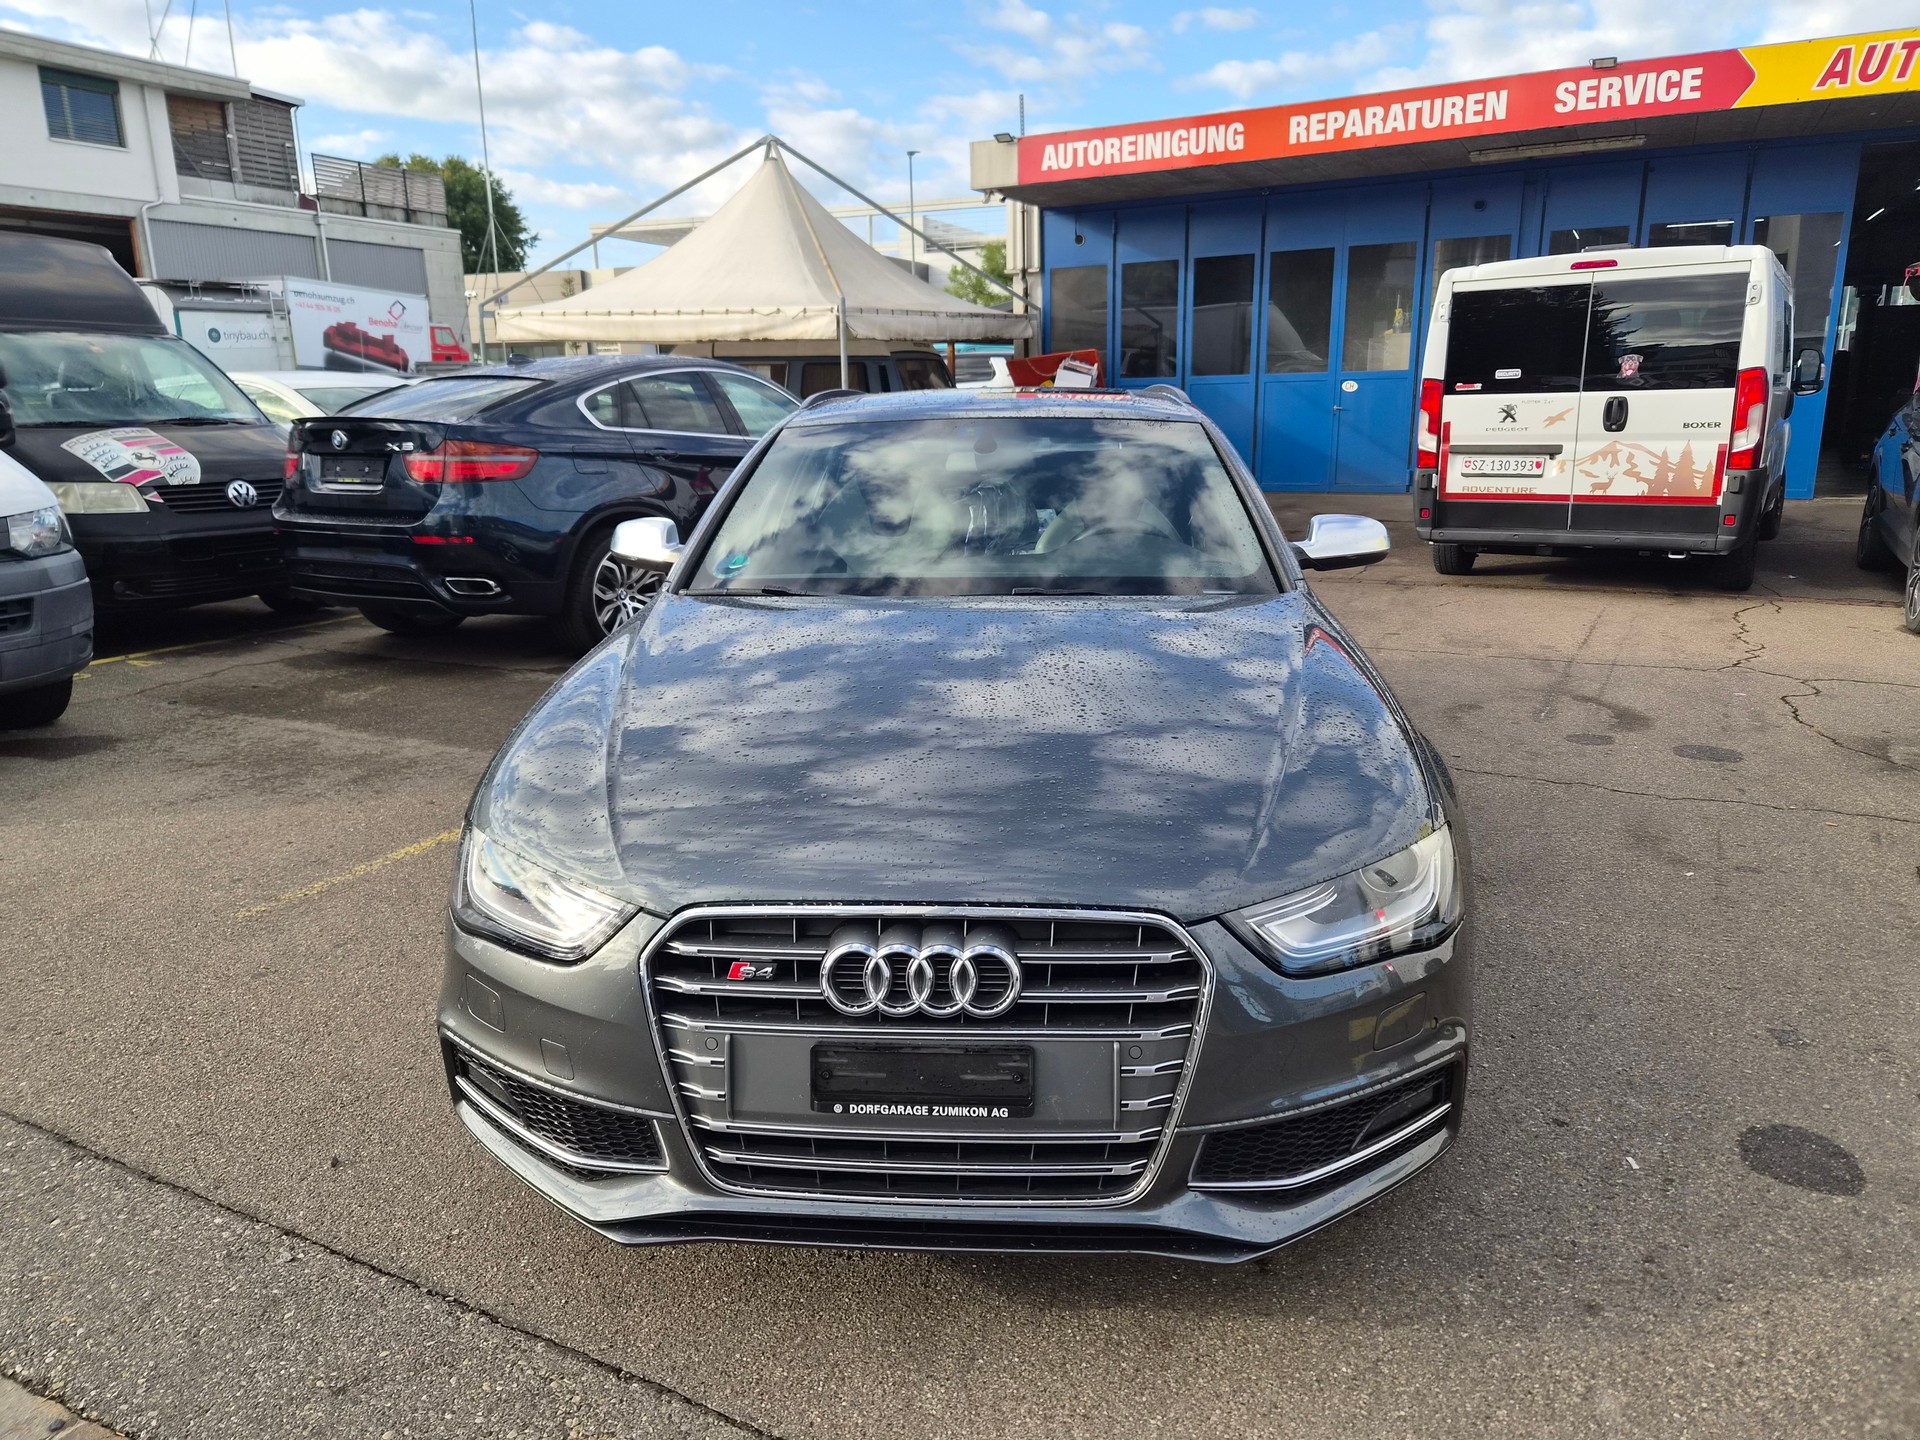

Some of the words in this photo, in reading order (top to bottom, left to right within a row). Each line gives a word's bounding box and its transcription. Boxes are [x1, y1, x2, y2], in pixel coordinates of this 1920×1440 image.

[1811, 38, 1920, 90] AUT
[1041, 122, 1245, 172] AUTOREINIGUNG
[1288, 89, 1509, 145] REPARATUREN
[1553, 66, 1704, 114] SERVICE
[223, 329, 270, 343] tinybau.ch
[1682, 421, 1722, 429] BOXER
[1461, 485, 1537, 494] ADVENTURE
[738, 966, 773, 979] S4
[849, 1104, 929, 1116] DORFGARAGE
[931, 1106, 988, 1118] ZUMIKON
[991, 1107, 1009, 1118] AG
